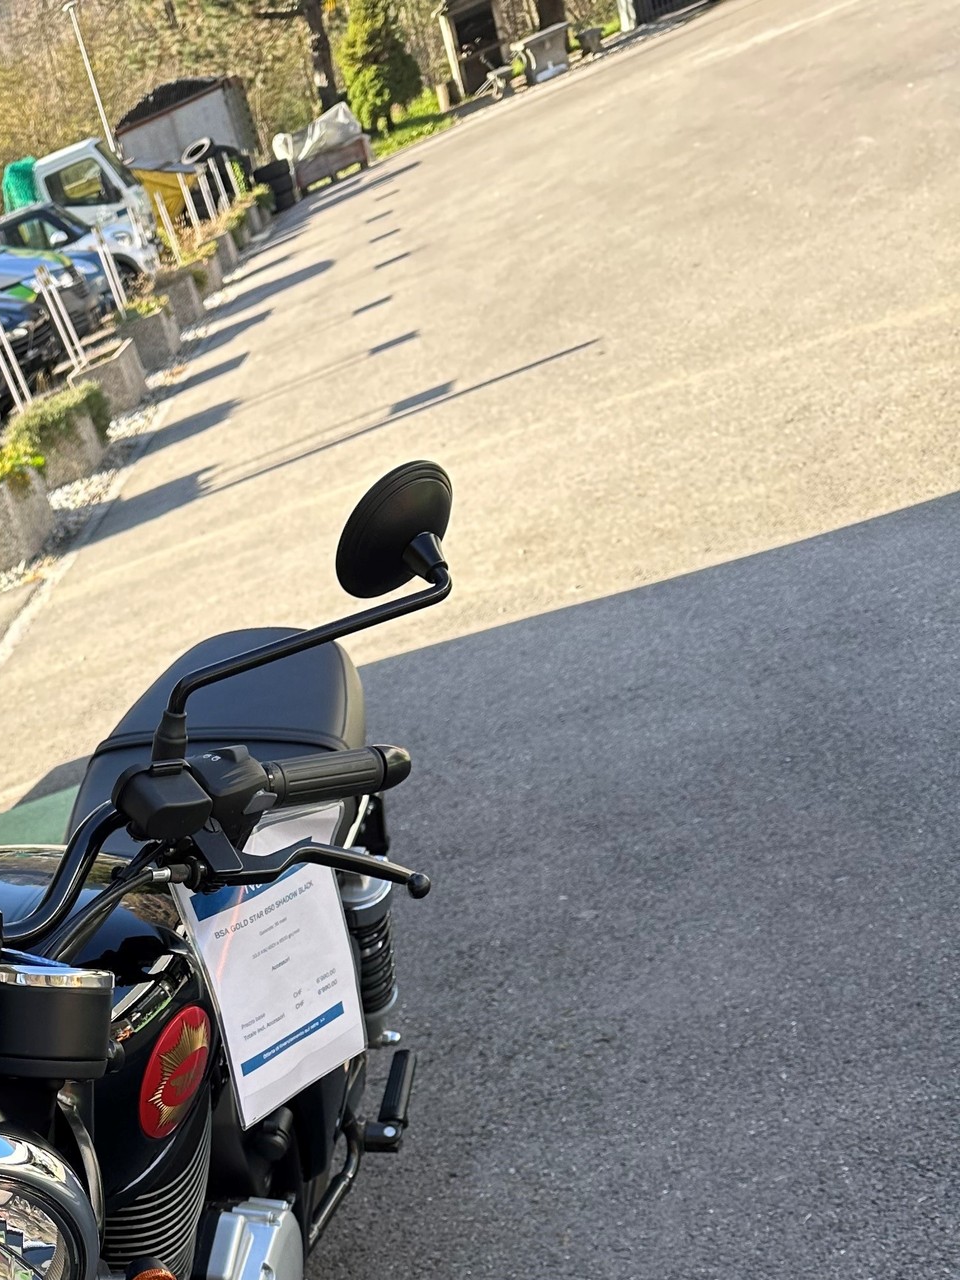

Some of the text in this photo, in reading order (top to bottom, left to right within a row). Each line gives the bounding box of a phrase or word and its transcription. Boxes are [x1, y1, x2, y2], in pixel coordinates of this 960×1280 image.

[214, 880, 314, 939] BSA GOLD STAR 650 SHADOW BLACK
[293, 988, 303, 999] CHF
[295, 999, 305, 1010] CHF
